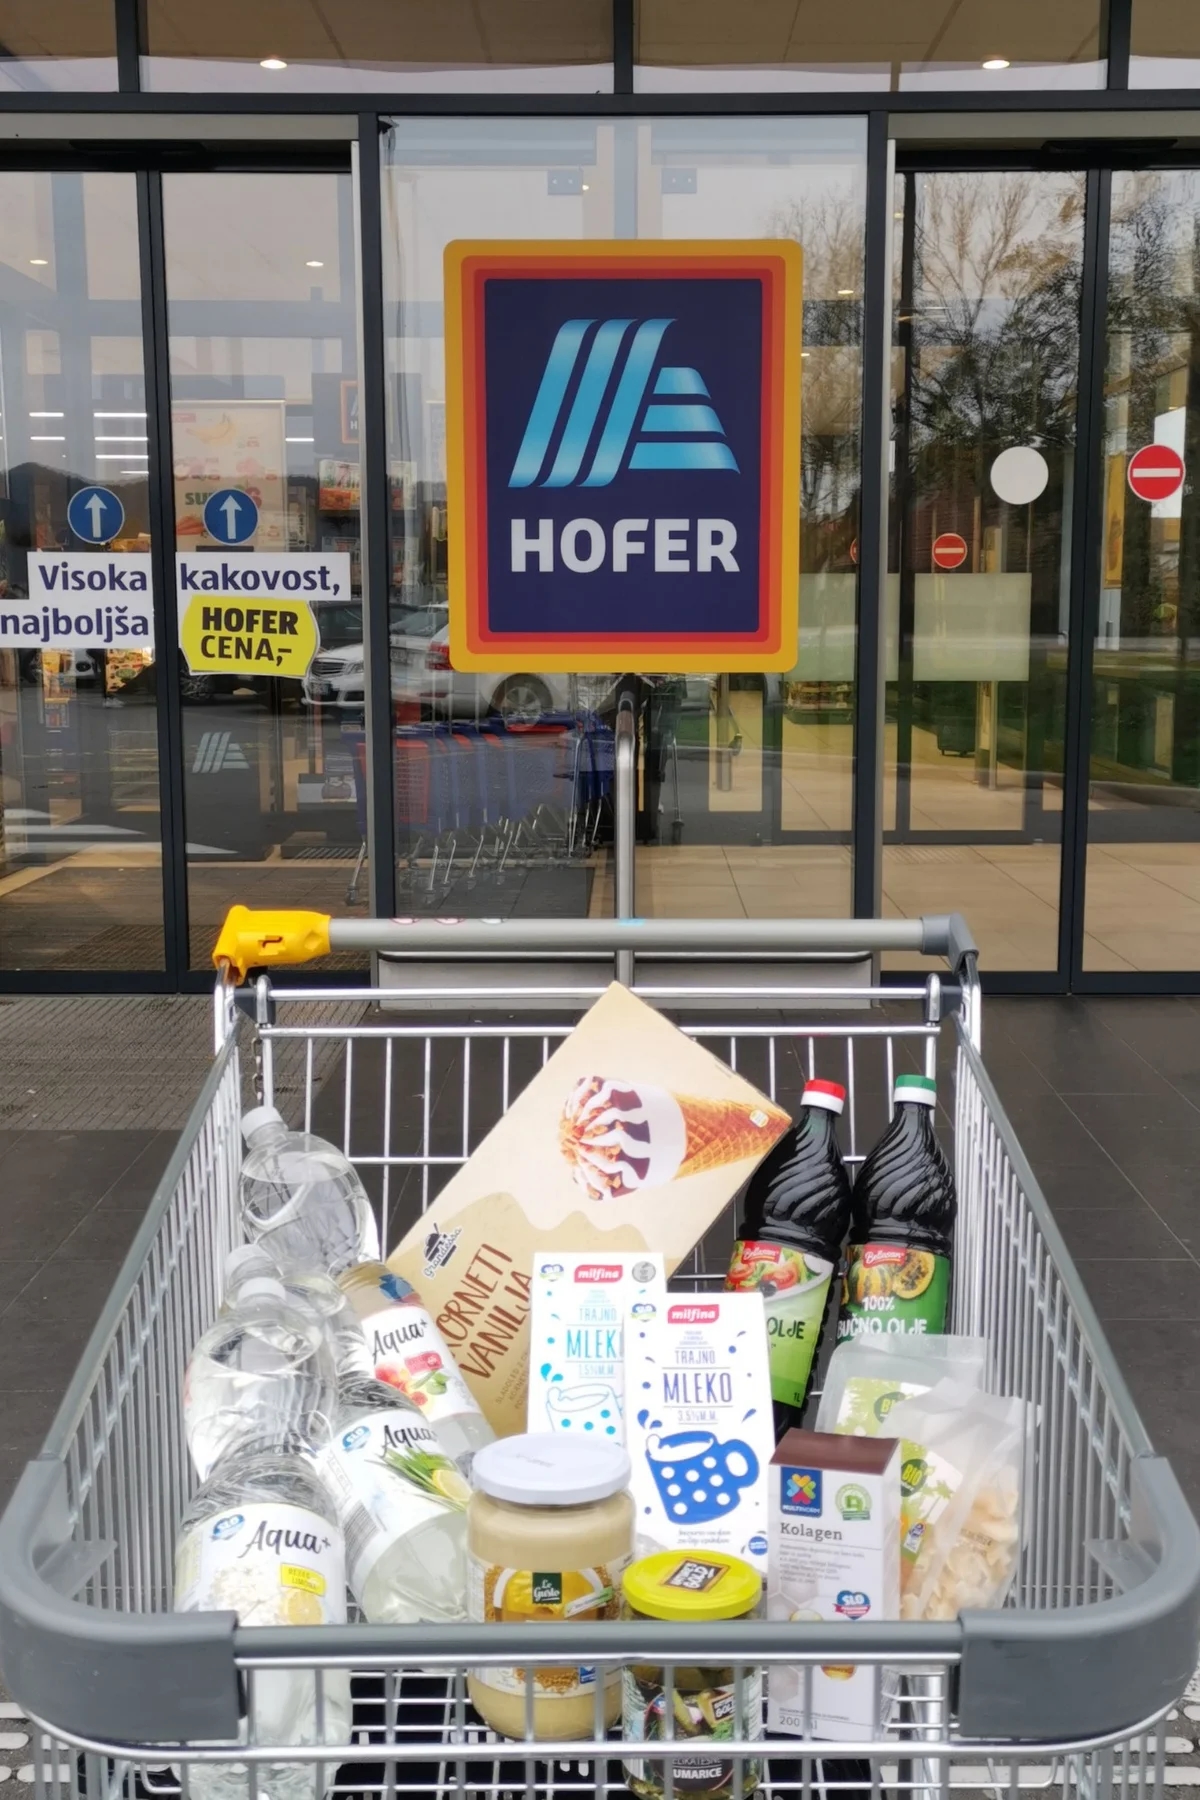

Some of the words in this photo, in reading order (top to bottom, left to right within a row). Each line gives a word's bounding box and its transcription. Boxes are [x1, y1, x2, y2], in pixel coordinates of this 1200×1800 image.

[511, 518, 740, 573] HOFER
[39, 562, 147, 591] Visoka
[180, 563, 340, 595] kakovost,
[0, 607, 149, 643] najboljša
[202, 607, 299, 635] HOFER
[578, 1268, 620, 1281] milfina
[436, 1243, 513, 1358] ORNETI
[862, 1296, 896, 1312] 100%
[579, 1308, 617, 1322] TRAJNO
[671, 1309, 716, 1323] milfina
[766, 1317, 806, 1339] OLJE
[887, 1318, 928, 1336] OLJE
[674, 1350, 716, 1365] TRAJNO
[663, 1372, 732, 1404] MLEKO
[901, 1464, 924, 1487] BIO
[237, 1520, 331, 1559] Aqua+
[780, 1522, 843, 1542] Kolagen
[541, 1578, 552, 1590] Le
[533, 1587, 561, 1602] Gusto
[780, 1716, 800, 1727] 200
[672, 1767, 722, 1779] UMARICE
